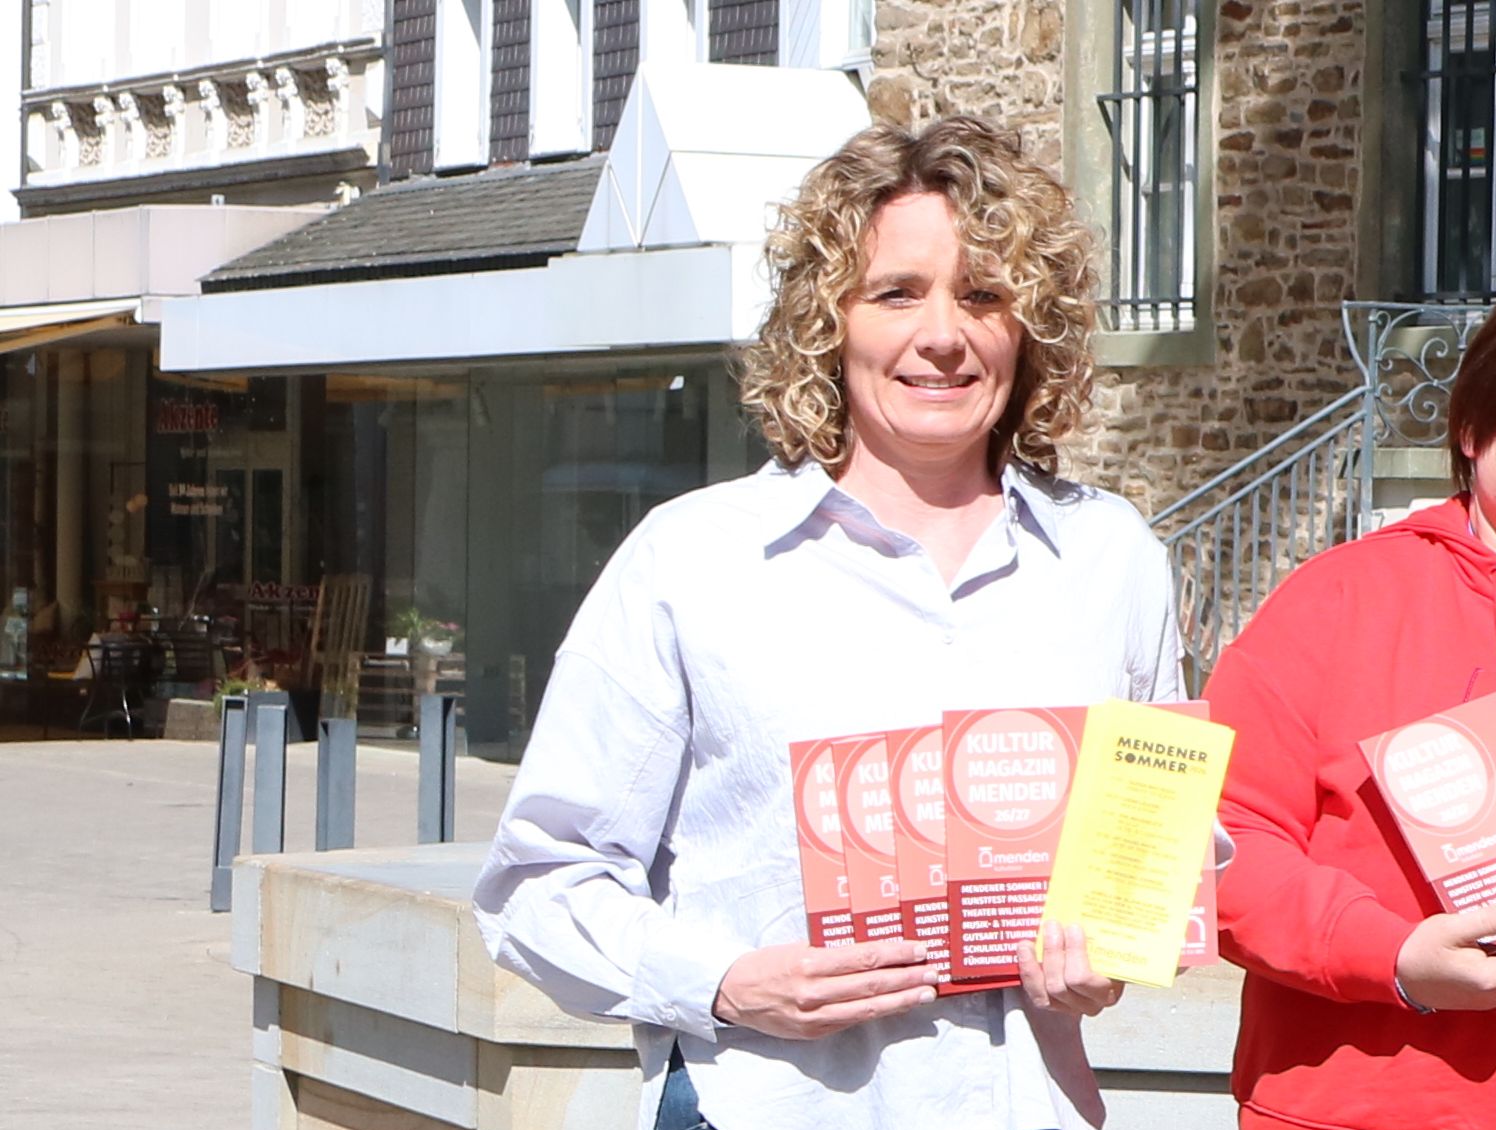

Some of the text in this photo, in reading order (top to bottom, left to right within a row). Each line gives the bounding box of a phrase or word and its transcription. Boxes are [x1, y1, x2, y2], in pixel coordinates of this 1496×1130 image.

[966, 730, 1055, 753] KULTUR
[1117, 736, 1208, 763] MENDENER
[1387, 732, 1463, 772] KULTUR
[967, 756, 1057, 778] MAGAZIN
[1115, 751, 1188, 774] SOMMER
[969, 780, 1057, 804] MENDEN
[992, 850, 1049, 865] menden
[961, 880, 1042, 894] MENDENER SOMMER
[961, 894, 1005, 906] KUNSTFEST
[962, 907, 997, 918] THEATER
[962, 931, 998, 942] GUTSART
